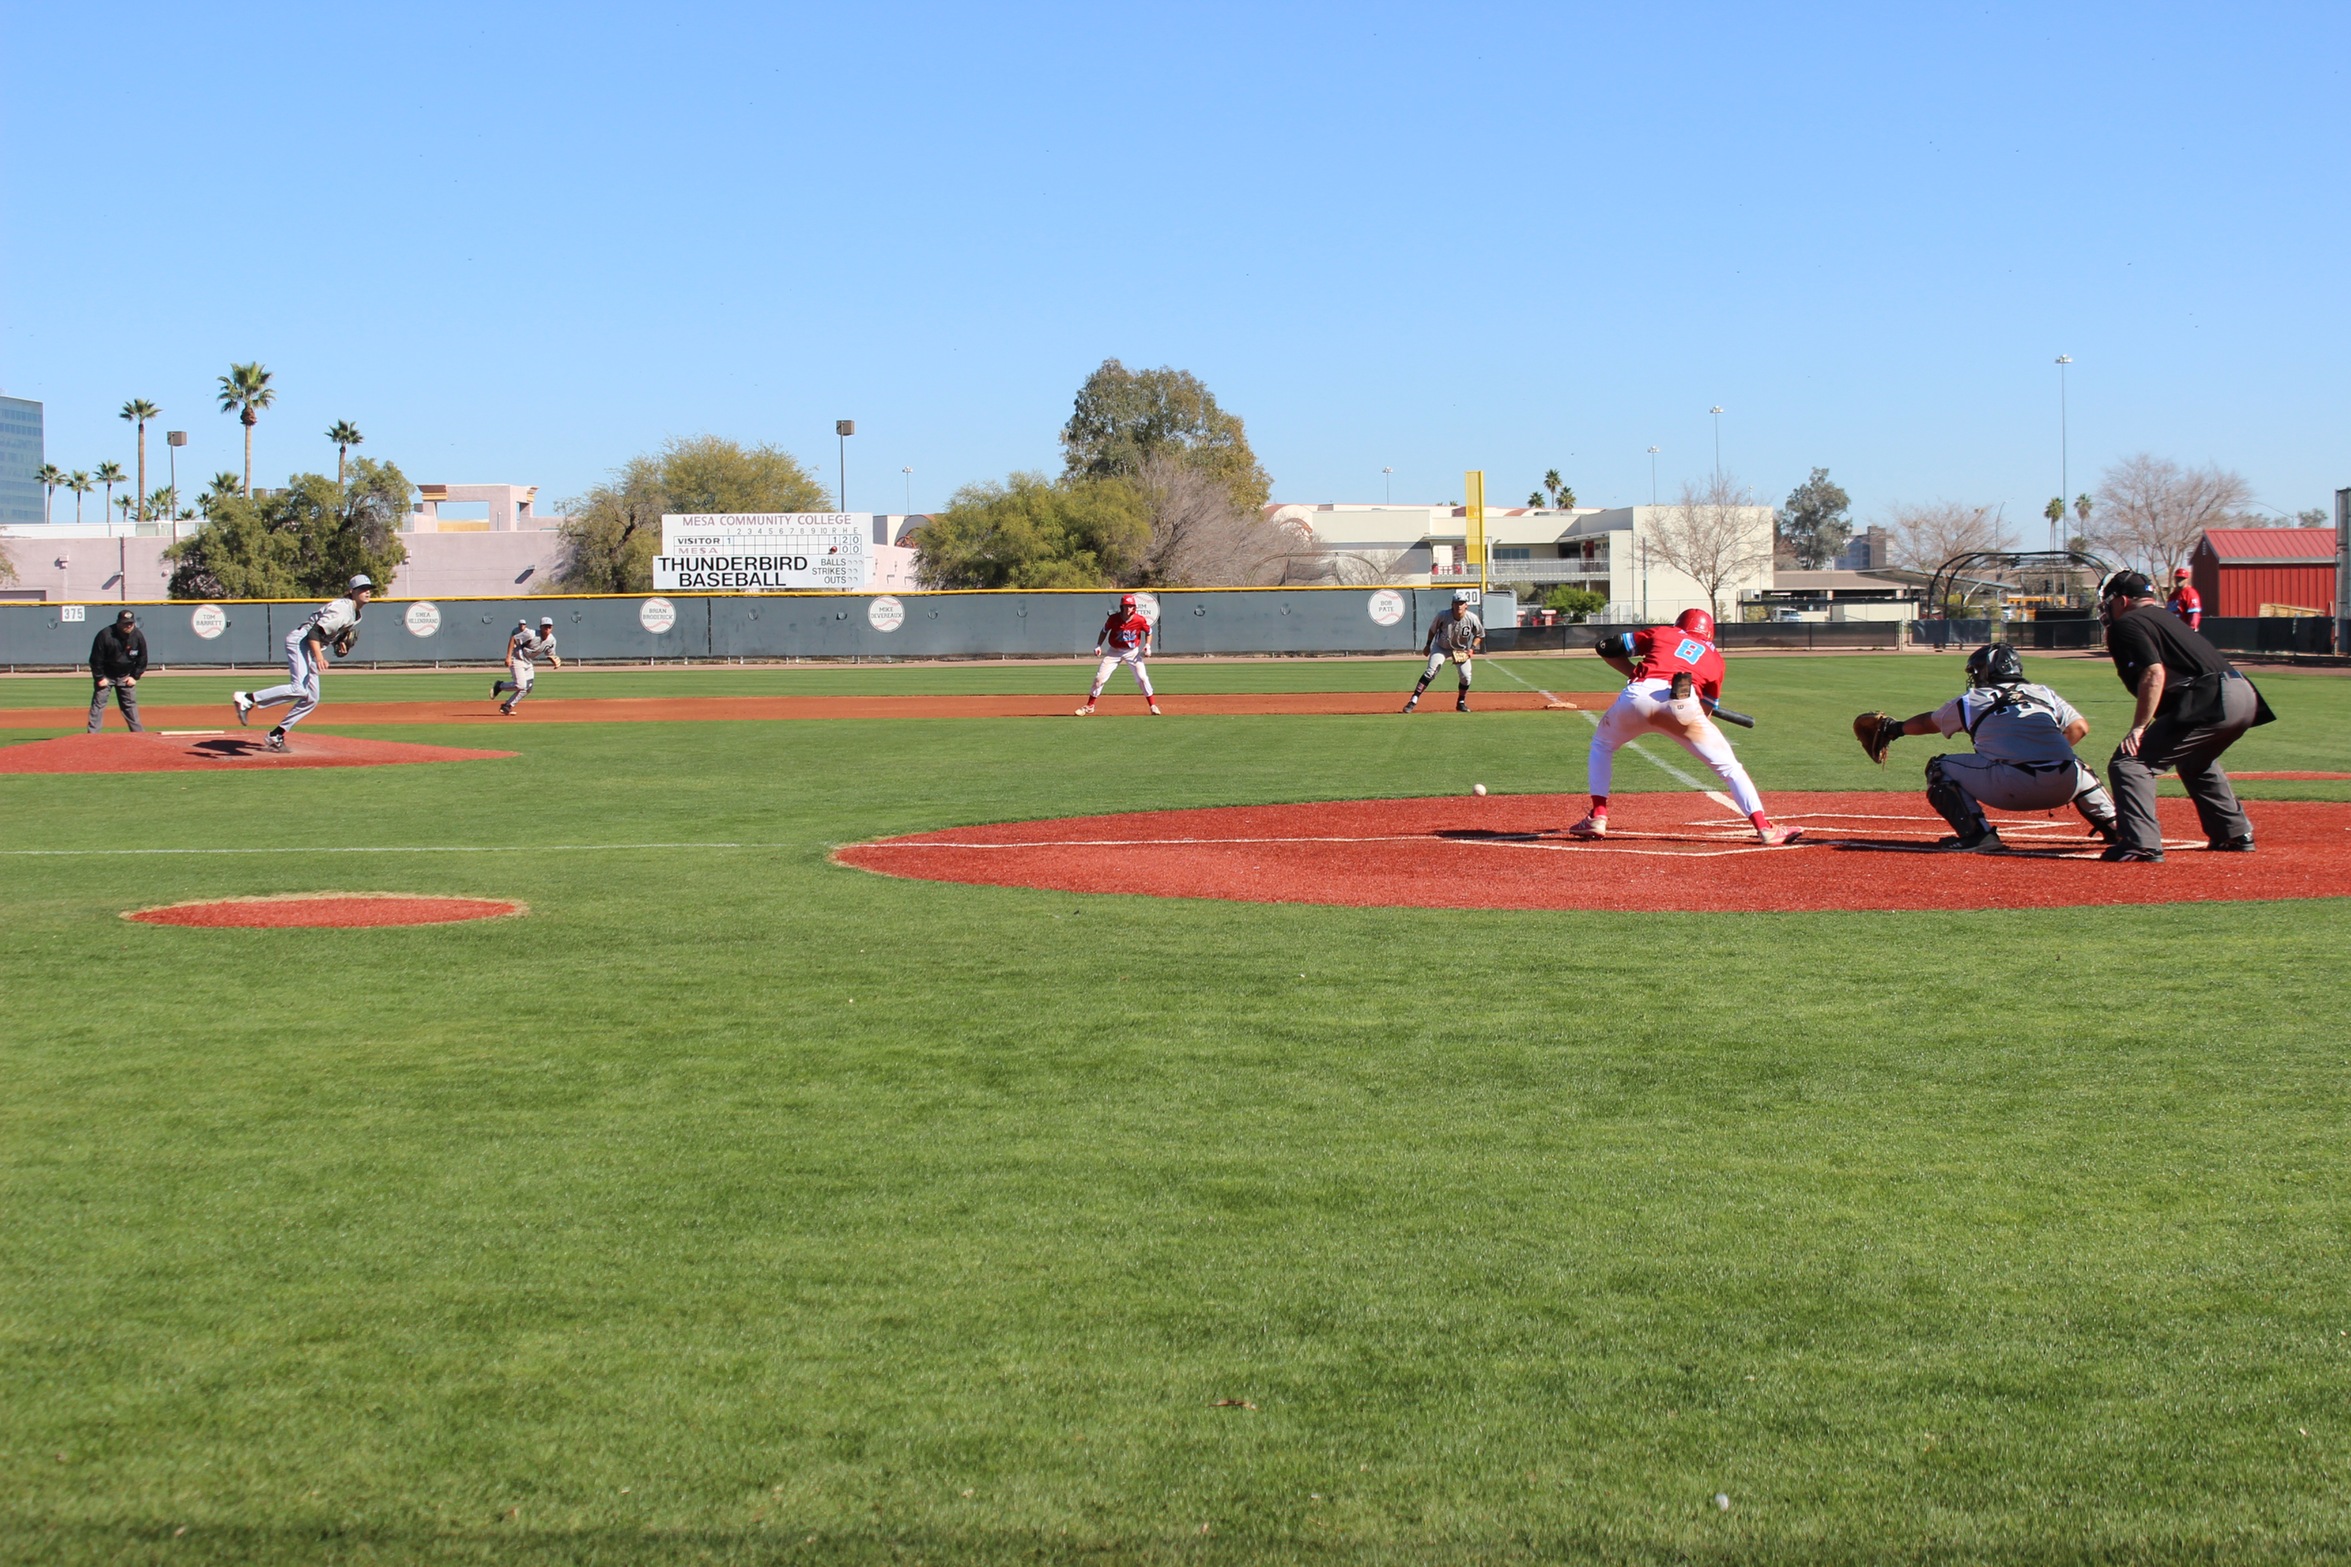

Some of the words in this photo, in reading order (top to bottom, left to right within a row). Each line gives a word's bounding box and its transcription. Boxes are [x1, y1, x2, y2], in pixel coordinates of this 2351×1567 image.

[682, 516, 716, 526] MESA
[719, 515, 792, 526] COMMUNITY
[797, 514, 852, 525] COLLEGE
[677, 537, 720, 545] VISITOR
[842, 536, 848, 544] 2
[852, 536, 859, 544] 0
[658, 556, 808, 572] THUNDERBIRD
[820, 558, 847, 566] BALLS
[811, 567, 847, 576] STRIKES
[679, 572, 787, 587] BASEBALL
[824, 576, 847, 584] OUTS
[64, 608, 83, 619] 375
[1674, 638, 1706, 665] 8
